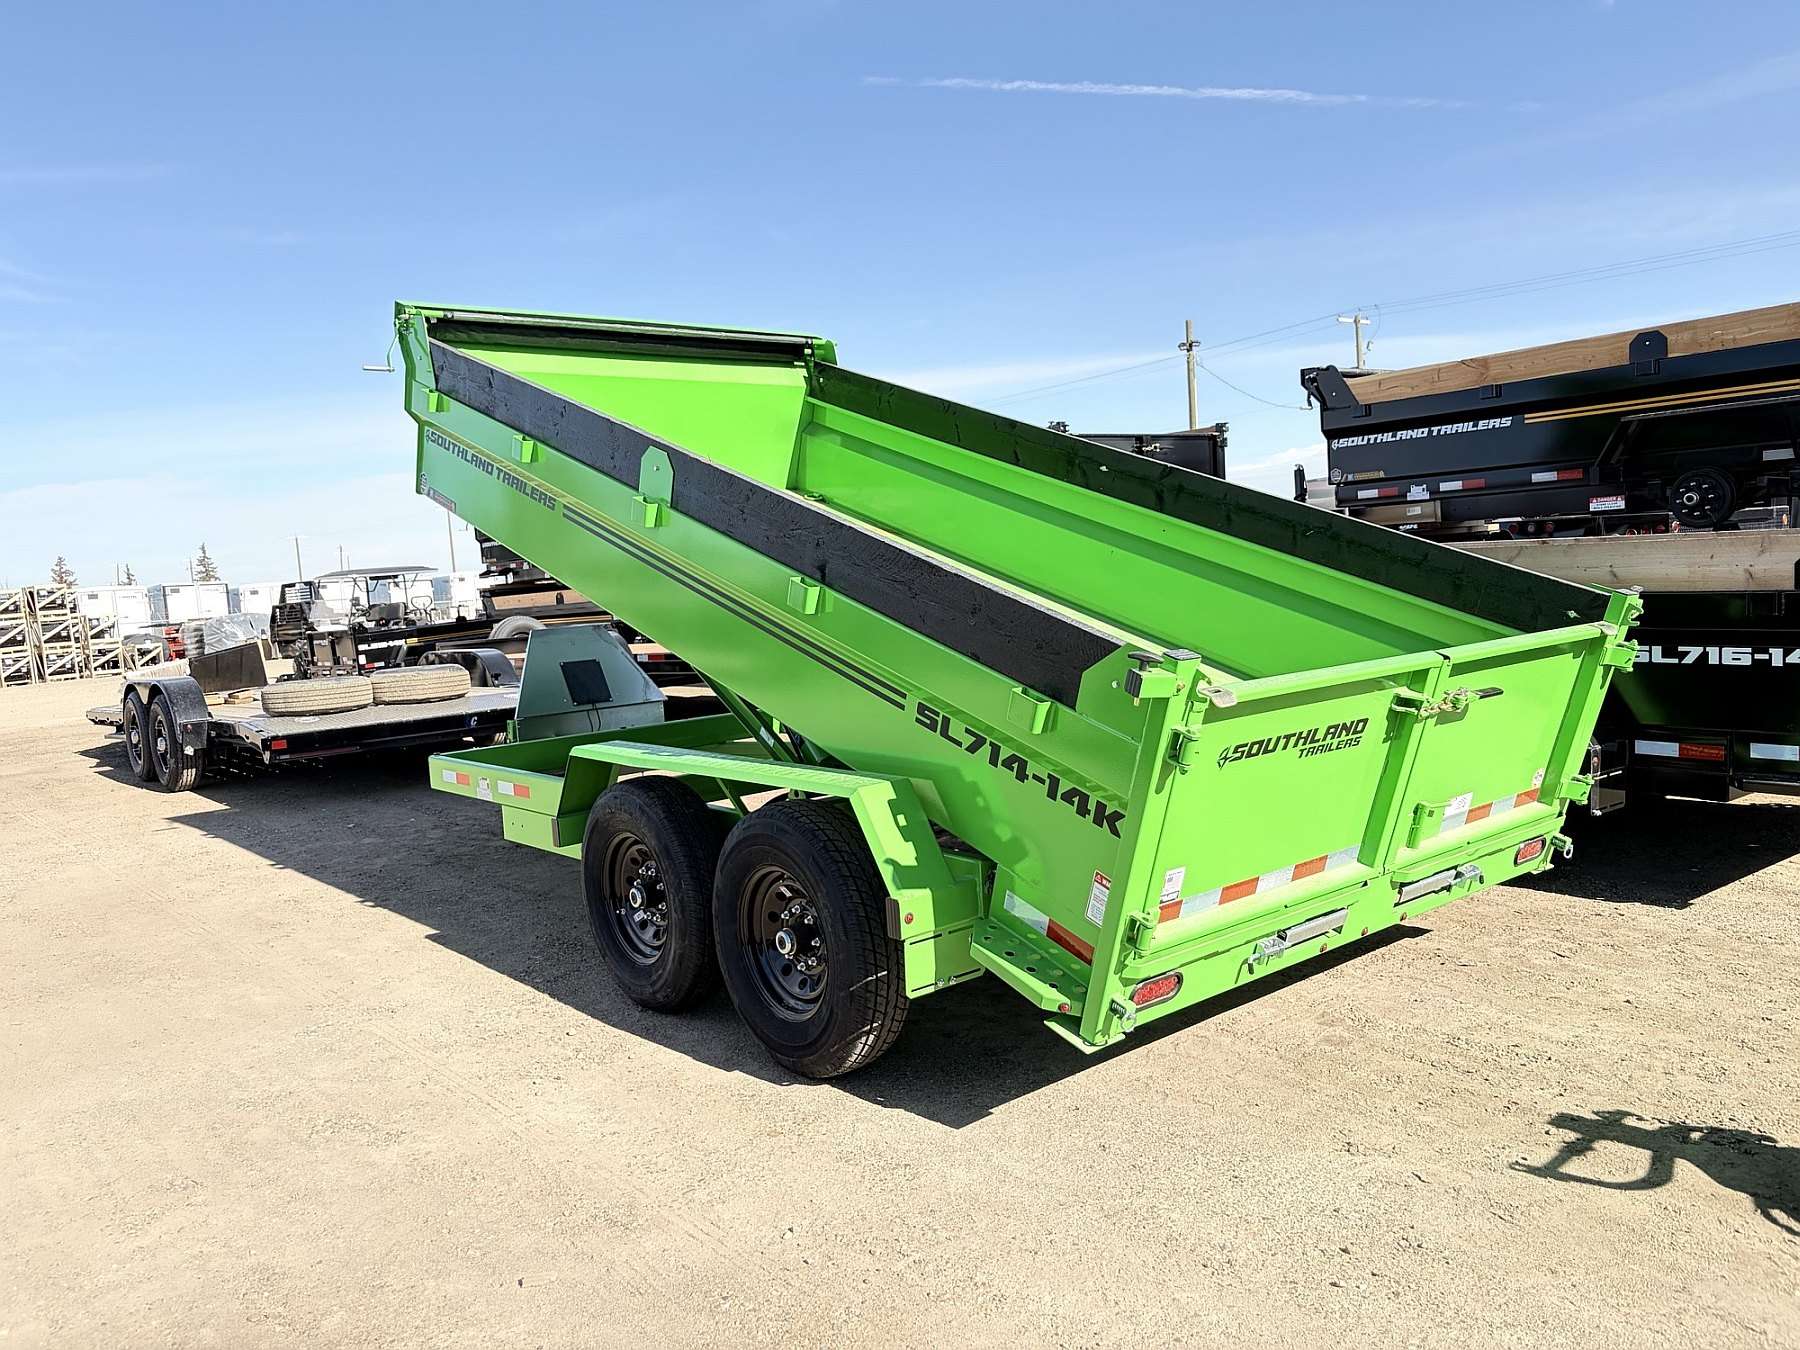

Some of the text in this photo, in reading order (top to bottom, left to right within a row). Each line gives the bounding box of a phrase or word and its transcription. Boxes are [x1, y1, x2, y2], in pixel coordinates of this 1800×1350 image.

[1338, 416, 1512, 448] SOUTHLAND TRAILERS
[430, 430, 494, 475] SOUTHLAND
[495, 467, 557, 511] TRAILERS
[1228, 717, 1369, 763] SOUTHLAND
[1298, 735, 1361, 759] TRAILERS
[914, 701, 1126, 839] SL714-14K
